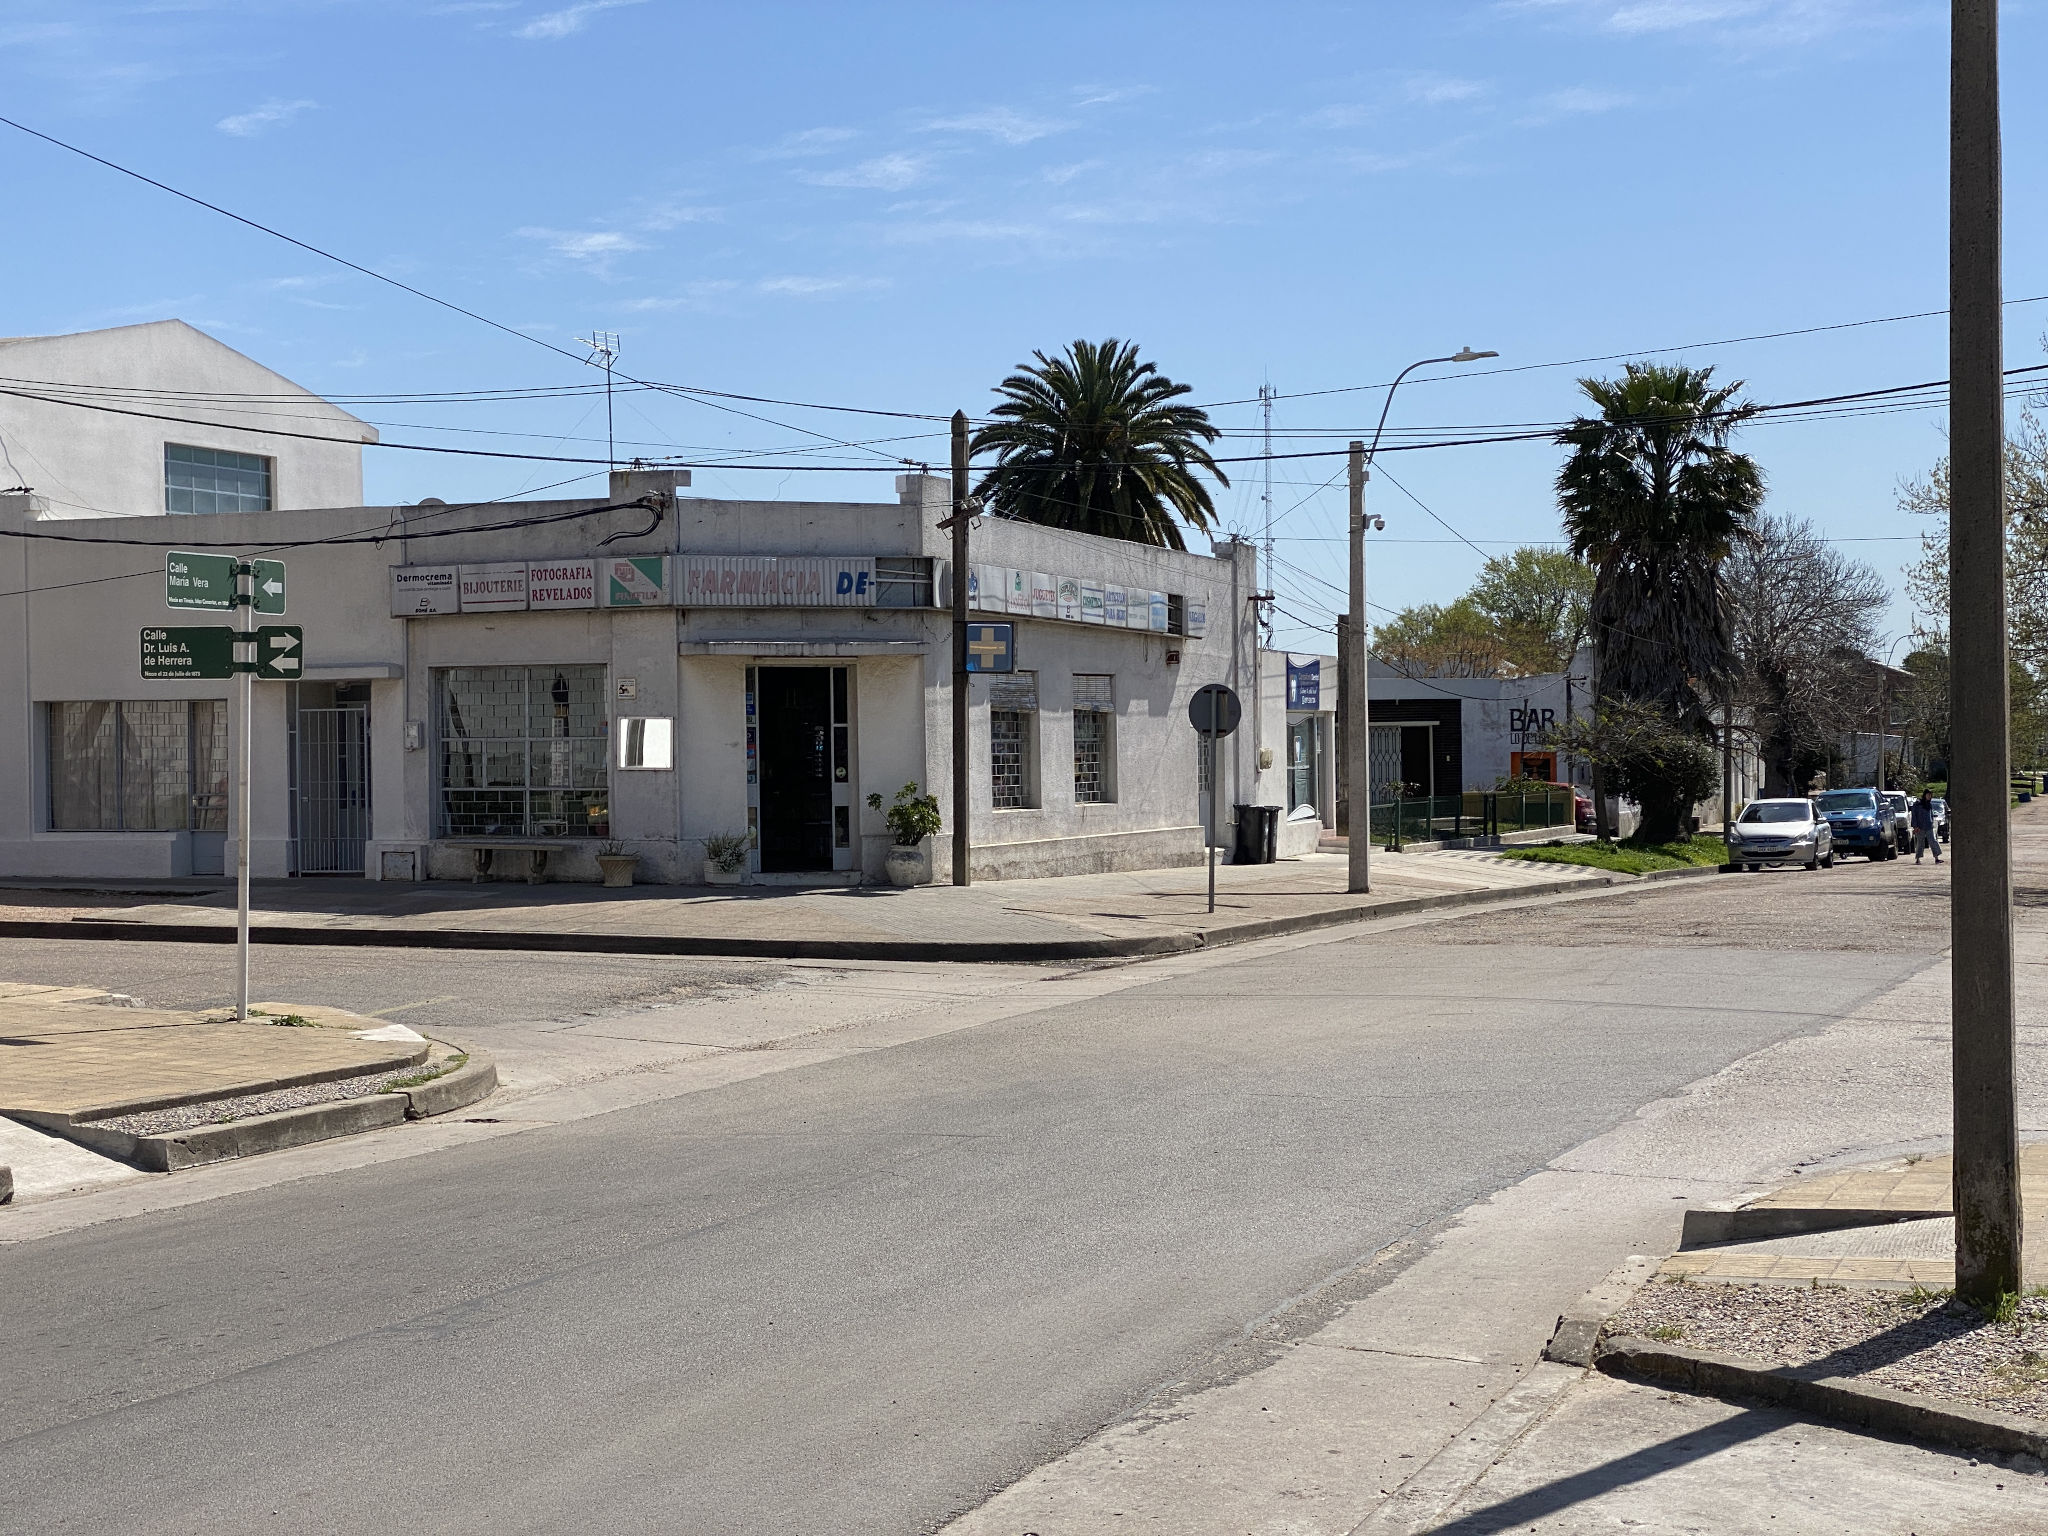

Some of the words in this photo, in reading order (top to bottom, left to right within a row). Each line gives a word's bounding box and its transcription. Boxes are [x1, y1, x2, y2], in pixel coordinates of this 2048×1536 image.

[169, 562, 188, 574] Calle
[530, 566, 593, 582] FOTOGRAFIA
[169, 575, 190, 587] María
[193, 577, 209, 588] Vera
[396, 573, 453, 583] Dermocrema
[687, 569, 822, 596] FARMACIA
[463, 578, 524, 595] BIJOUTERIE
[531, 586, 593, 602] REVELADOS
[143, 630, 167, 640] Calle
[143, 643, 156, 653] Dr.
[158, 643, 178, 653] Luis
[179, 643, 190, 653] A.
[143, 655, 156, 666] de
[157, 655, 192, 666] Herrera
[1508, 708, 1555, 732] BAR
